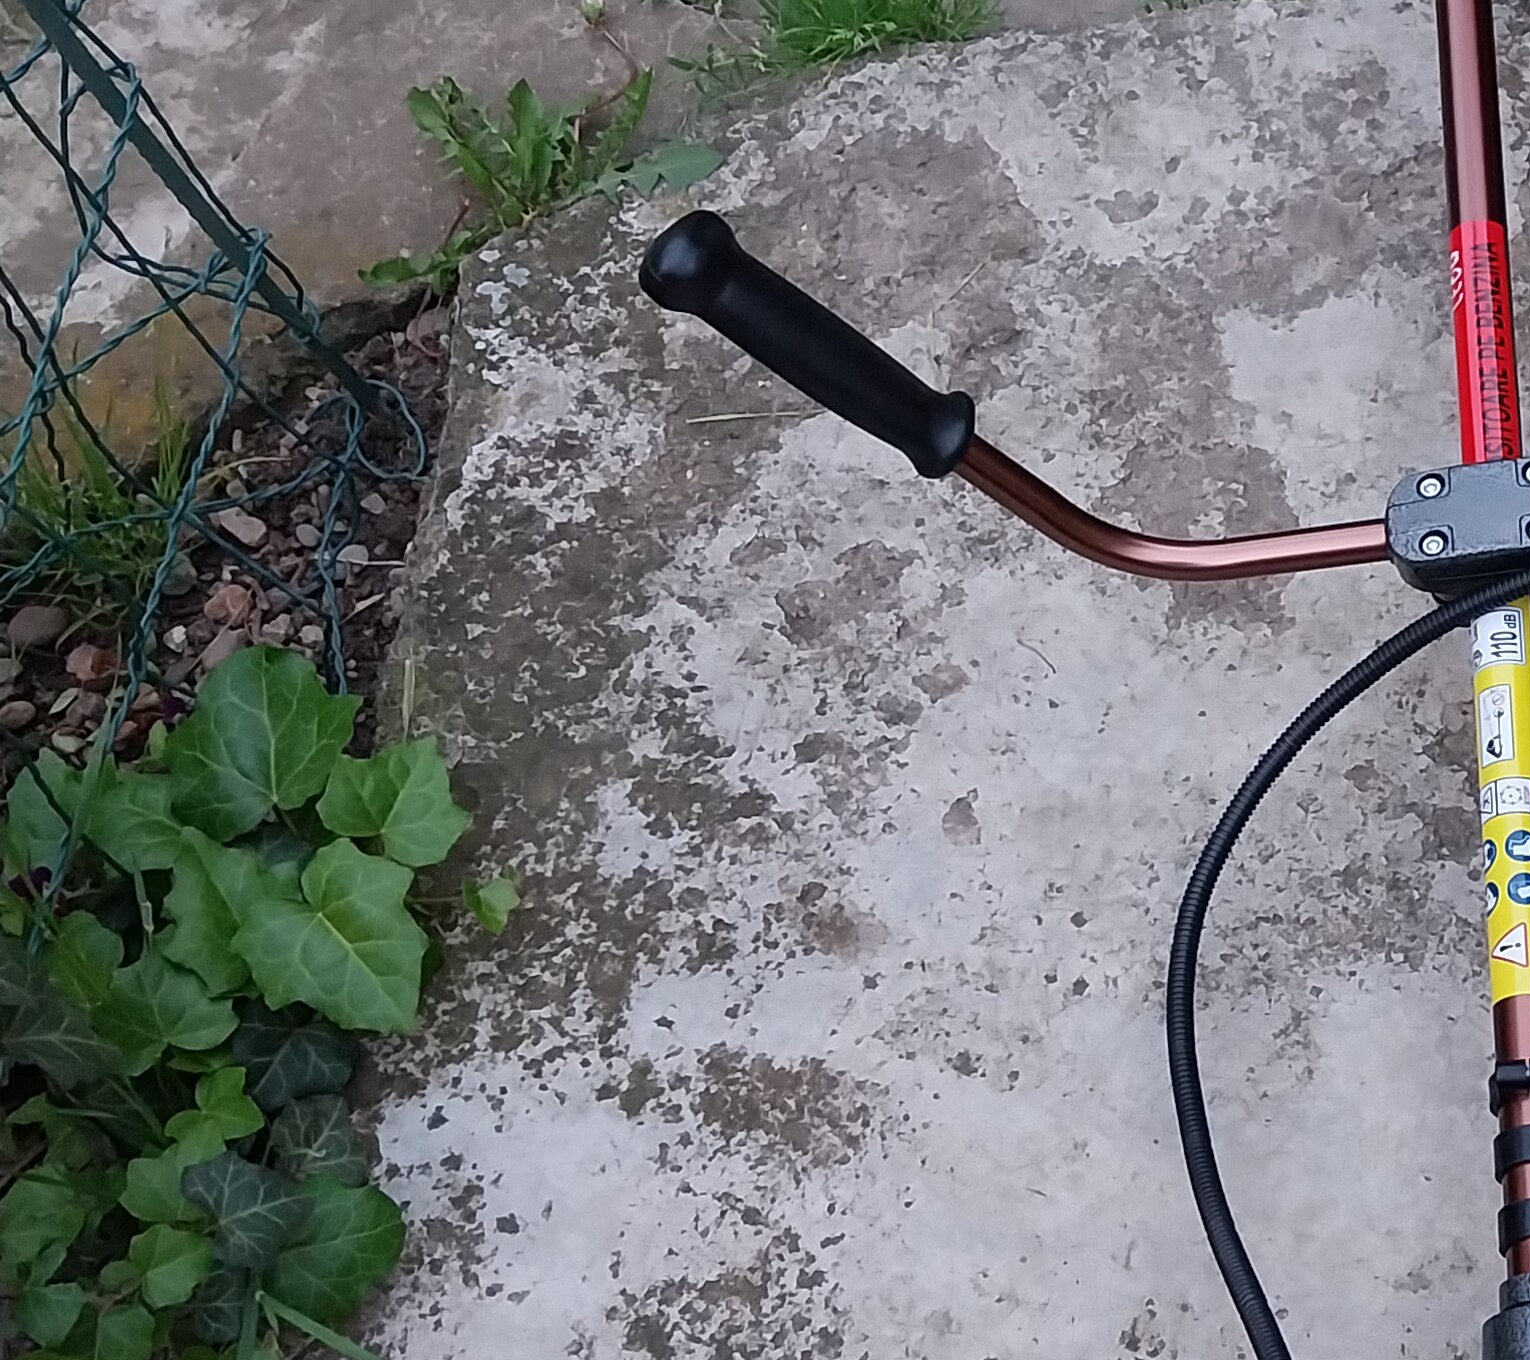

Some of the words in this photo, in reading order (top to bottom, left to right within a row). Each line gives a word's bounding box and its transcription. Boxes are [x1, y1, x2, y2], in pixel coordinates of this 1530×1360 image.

[1471, 242, 1504, 329] BENZINA
[1477, 335, 1505, 361] PE
[1503, 614, 1517, 629] dB
[1490, 631, 1518, 658] 110
